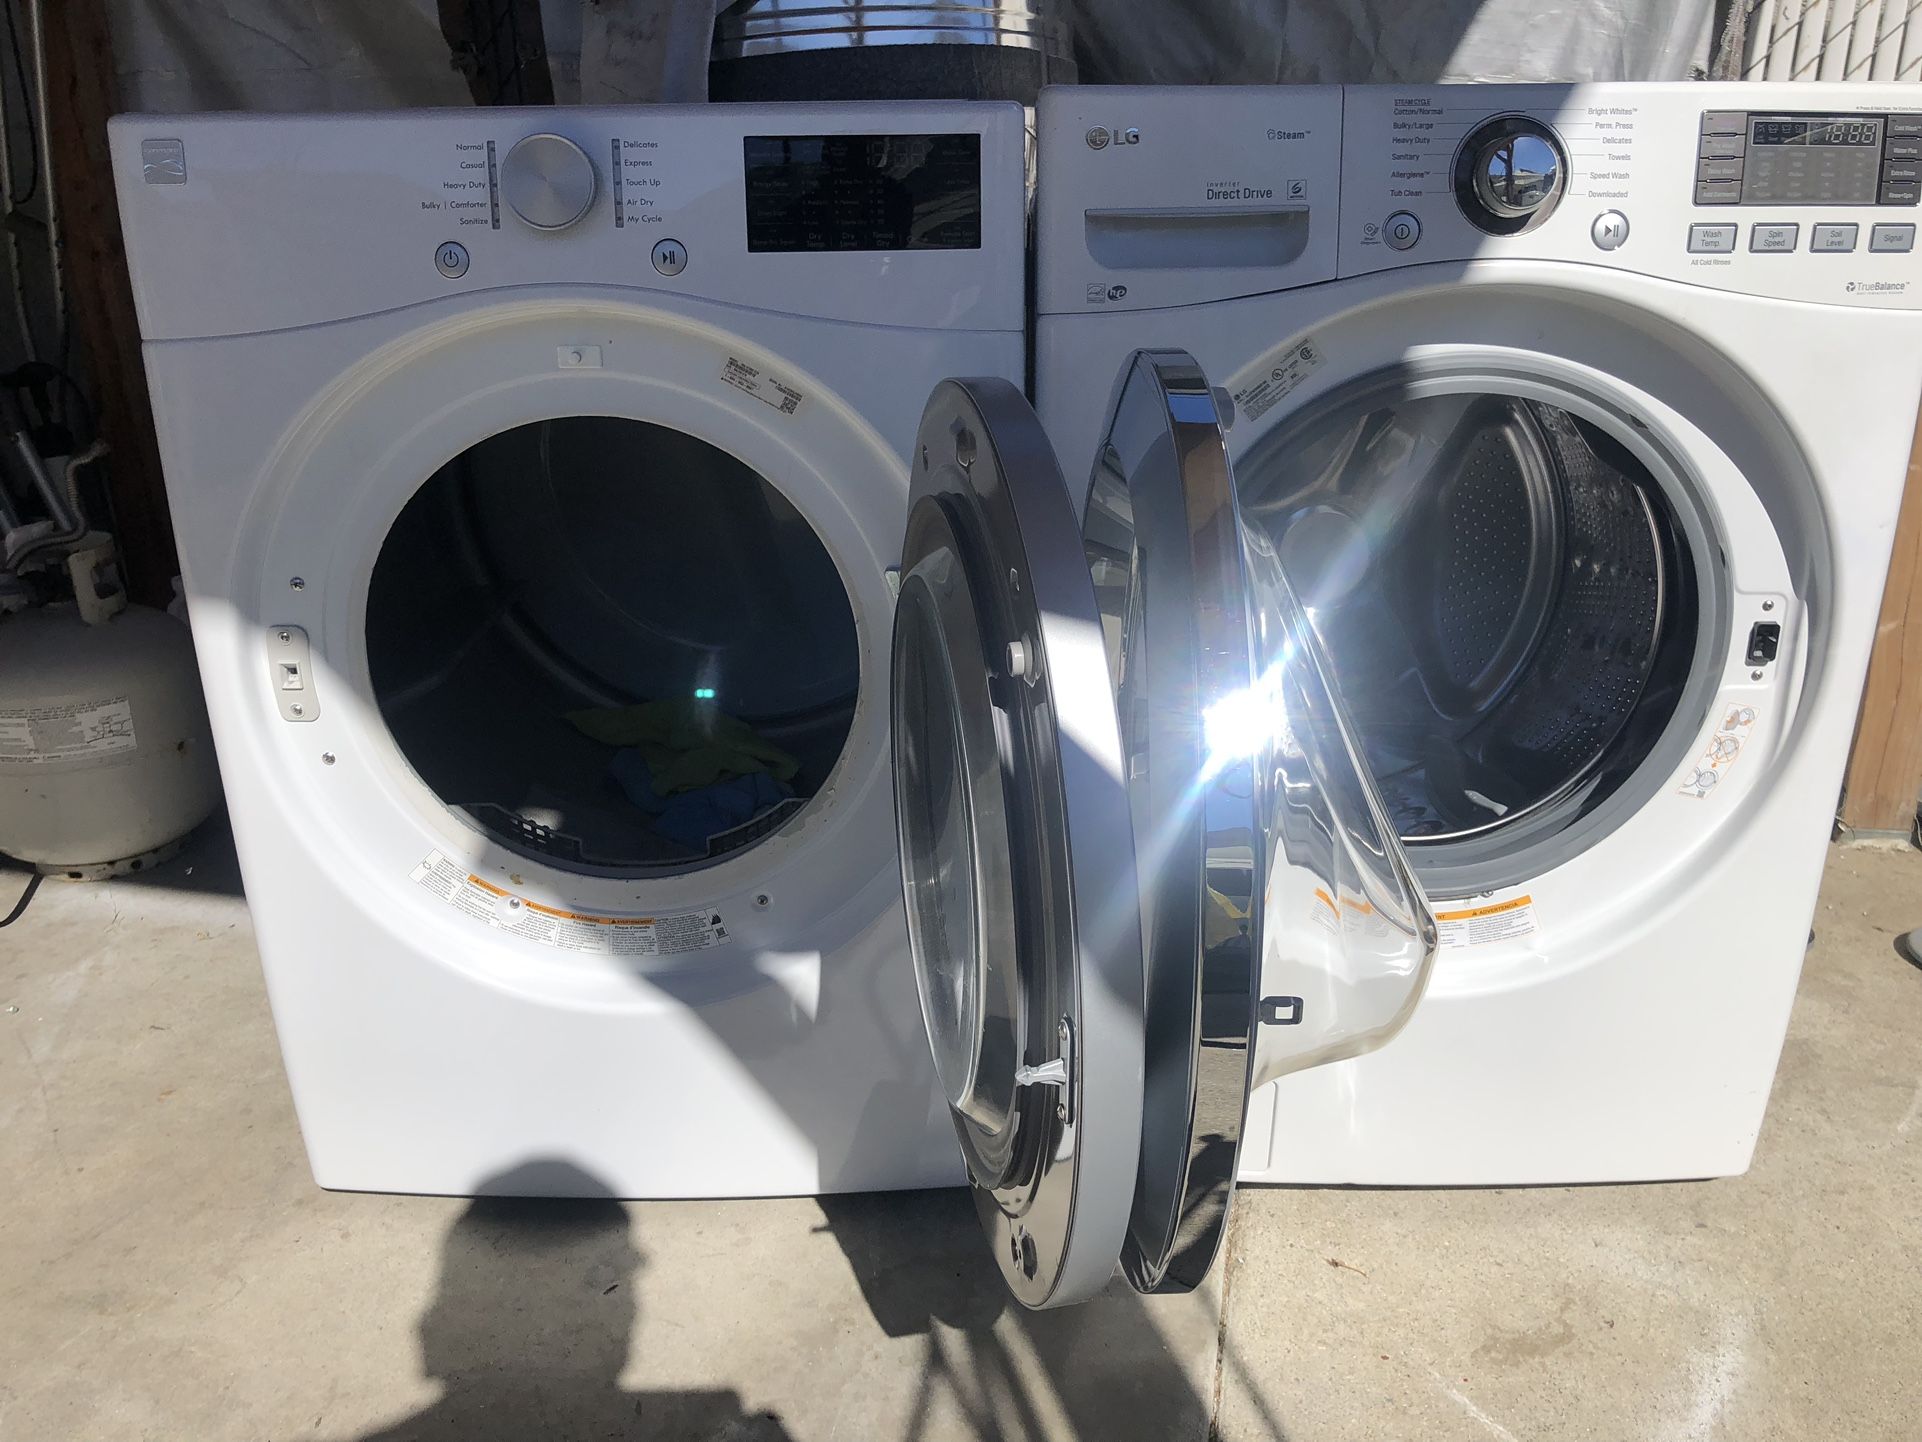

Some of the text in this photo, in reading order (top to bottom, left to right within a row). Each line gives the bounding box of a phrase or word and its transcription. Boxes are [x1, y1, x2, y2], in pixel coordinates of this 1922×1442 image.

[1588, 107, 1608, 116] Bright
[1393, 121, 1434, 130] Bulky/Large
[1113, 127, 1140, 145] LG
[623, 141, 658, 149] Delicates
[1392, 137, 1430, 145] Heavy Duty
[456, 143, 484, 151] Normal
[1392, 153, 1420, 161] Sanitary
[1608, 153, 1631, 161] Towels
[460, 161, 485, 169] Casual
[624, 159, 652, 168] Express
[1590, 171, 1629, 181] Speed Wash
[443, 181, 486, 190] Heavy Duty
[626, 178, 661, 188] Touch Up
[1206, 188, 1273, 200] Direct Drive
[421, 201, 487, 210] Bulky Comforter
[626, 198, 654, 208] Air Dry
[459, 217, 488, 225] Sanitize
[627, 215, 662, 224] My Cycle
[1702, 230, 1722, 238] Wash
[1768, 230, 1783, 239] Spin
[1830, 230, 1843, 238] Soil
[1884, 234, 1903, 243] Signal
[1763, 239, 1785, 248] Speed
[1826, 239, 1844, 247] Level
[1713, 258, 1731, 266] Rinses
[1479, 902, 1518, 915] ADVERTENCIA
